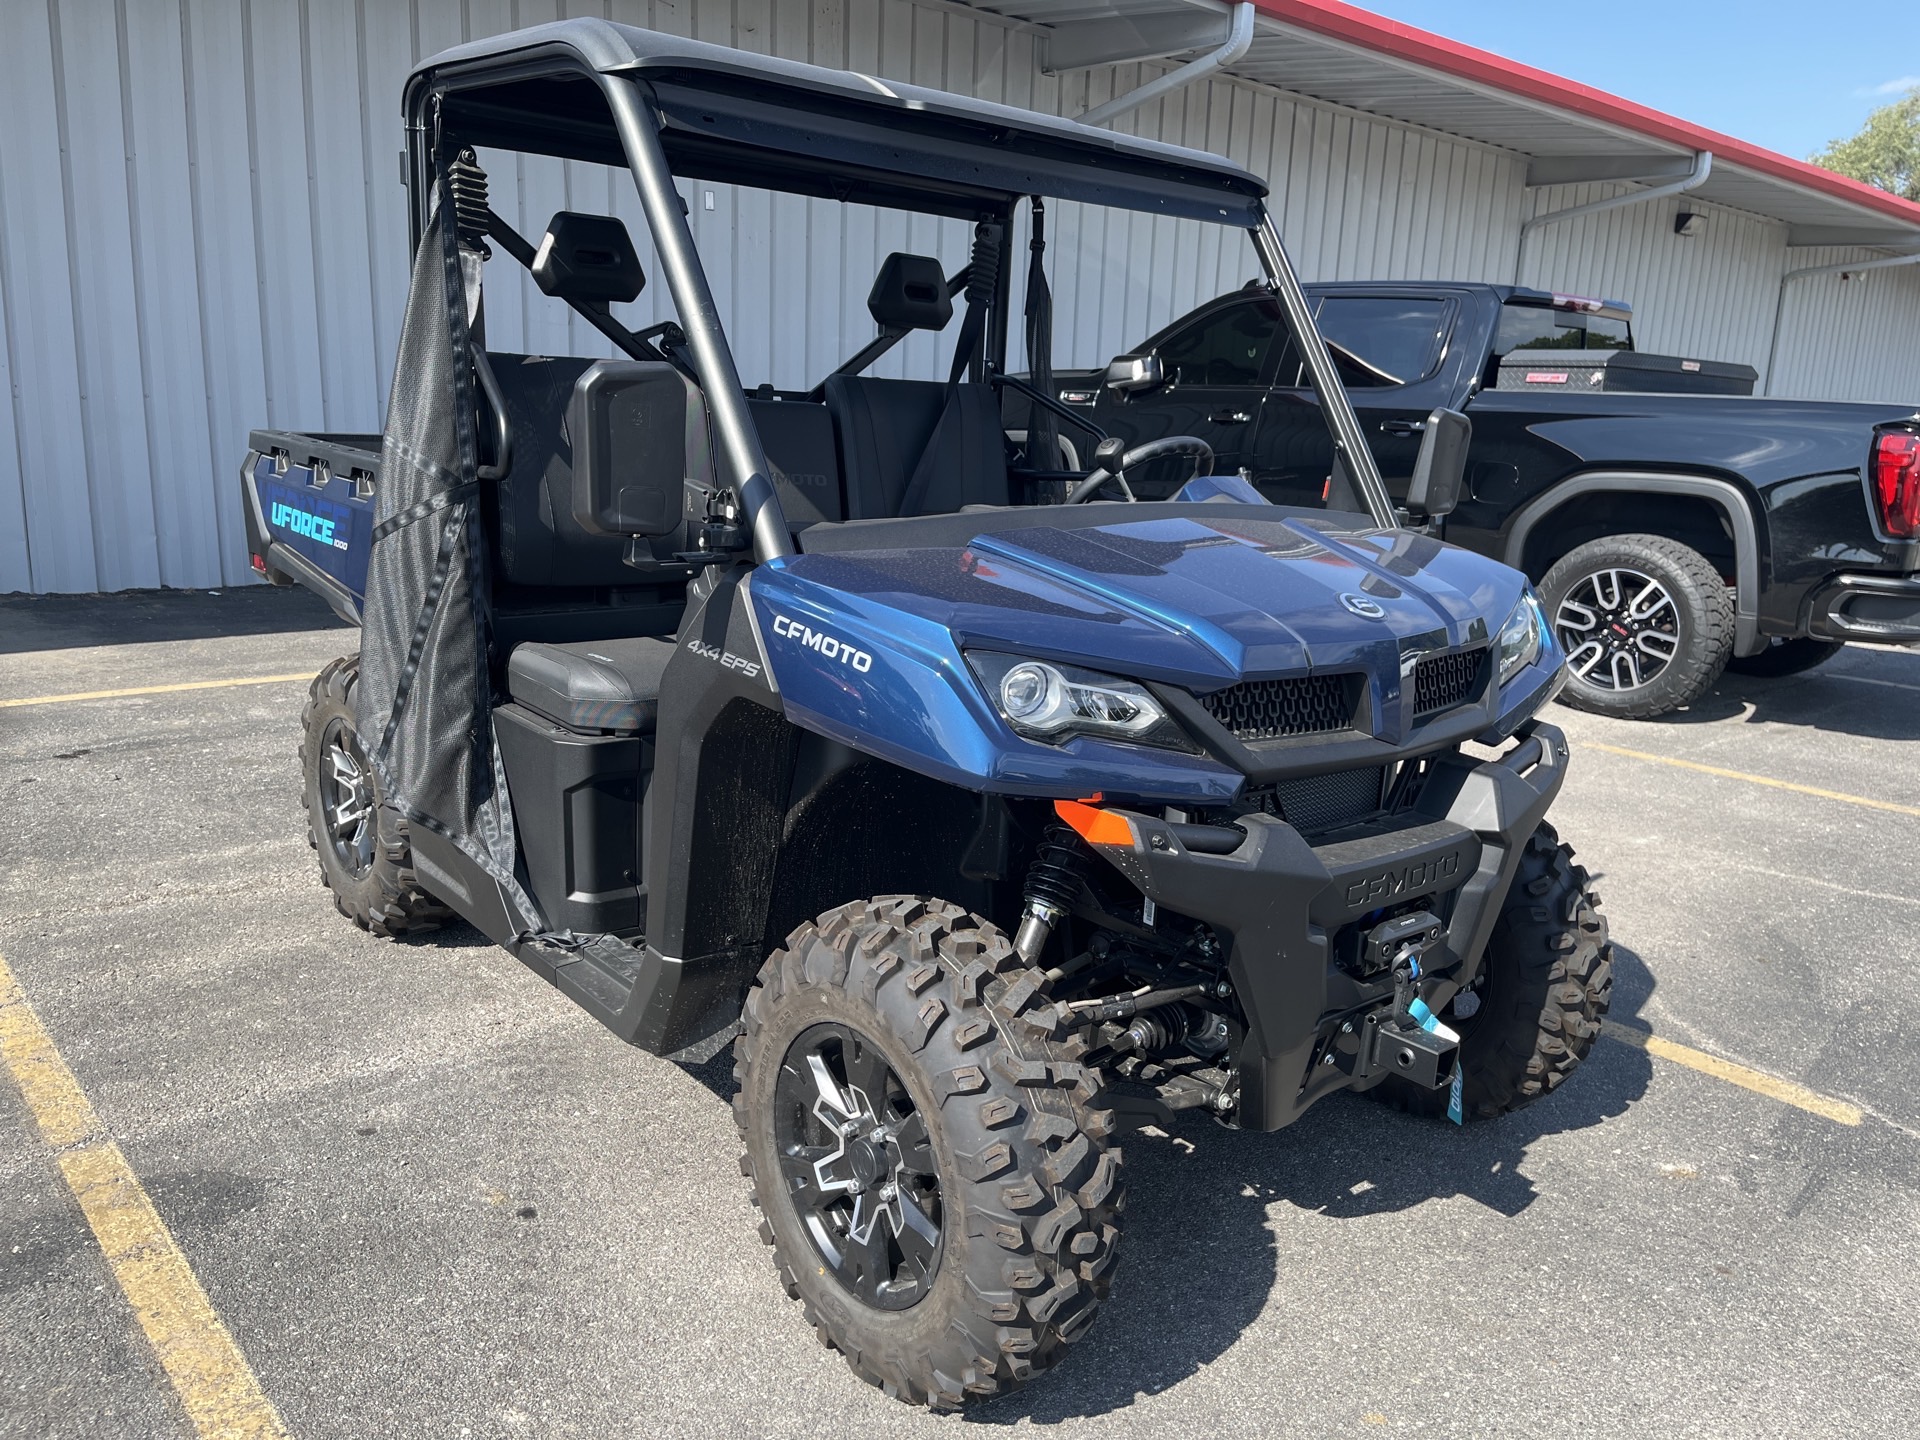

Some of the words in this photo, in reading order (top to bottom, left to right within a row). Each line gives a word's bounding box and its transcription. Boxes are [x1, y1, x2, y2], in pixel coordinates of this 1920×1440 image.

[769, 472, 828, 487] MOTO
[272, 502, 335, 546] UFORCE
[333, 538, 348, 551] 1000
[773, 614, 873, 673] CFMOTO
[1612, 623, 1628, 636] GMC
[687, 639, 720, 661] 4X4
[720, 651, 761, 678] EPS
[1345, 851, 1460, 908] CFMOTO
